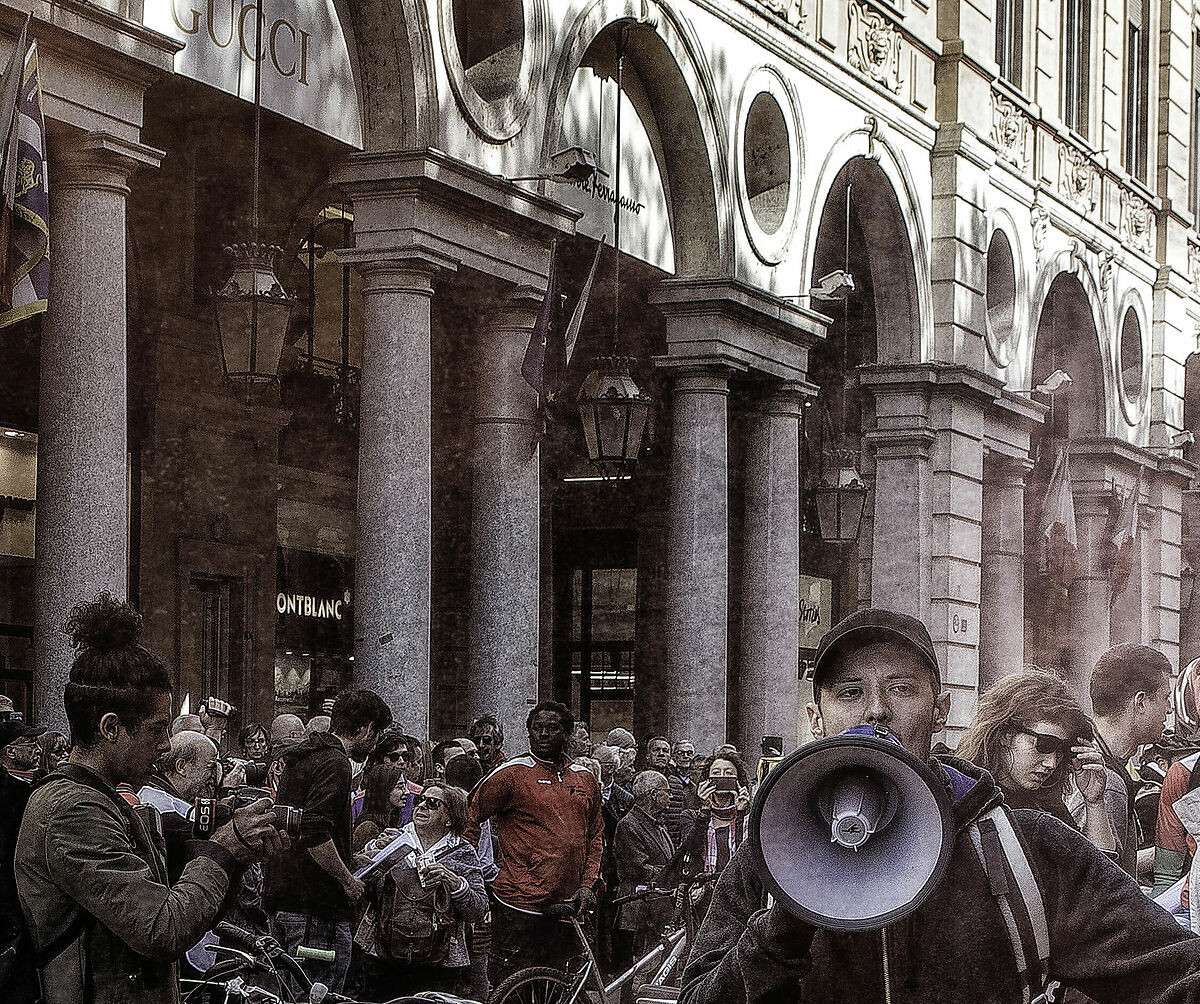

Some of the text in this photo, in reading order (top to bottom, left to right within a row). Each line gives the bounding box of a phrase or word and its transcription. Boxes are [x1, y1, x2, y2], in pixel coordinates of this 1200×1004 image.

[171, 0, 312, 87] GUCCI
[276, 592, 342, 620] ONTBLANC
[199, 805, 210, 832] EOS
